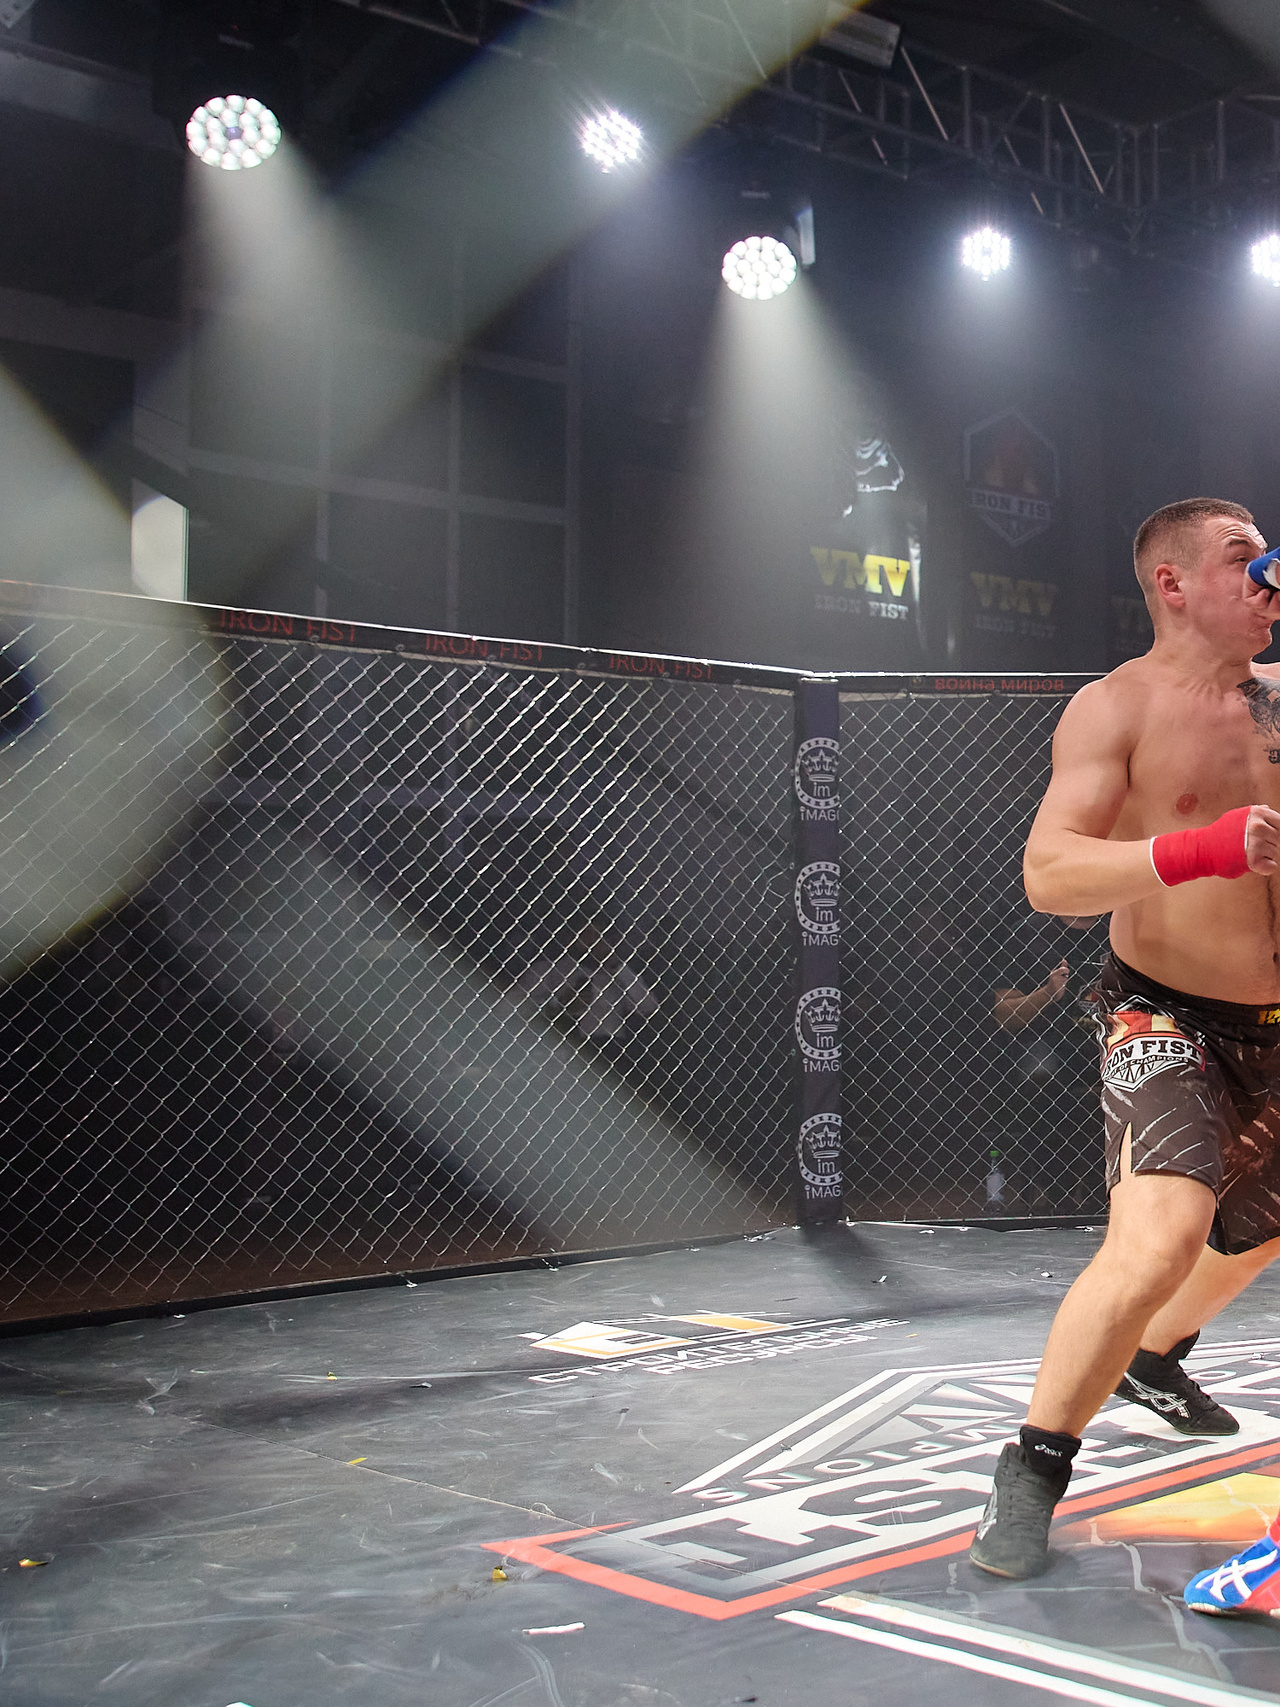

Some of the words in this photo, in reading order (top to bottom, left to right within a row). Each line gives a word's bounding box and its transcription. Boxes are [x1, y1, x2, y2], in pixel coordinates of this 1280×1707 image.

[810, 546, 911, 597] VMV
[868, 601, 910, 620] FIST
[218, 610, 293, 636] IRON
[306, 620, 357, 642] FIST
[424, 634, 489, 657] IRON
[499, 643, 544, 661] FIST
[608, 655, 666, 674] IRON
[673, 663, 714, 679] FIST
[813, 782, 831, 797] im
[815, 907, 834, 921] im
[816, 1033, 835, 1048] im
[1140, 1040, 1201, 1060] FIST
[817, 1159, 836, 1174] im
[528, 1318, 911, 1384] СТРОИТЕЛЬНЫЕ
[641, 1334, 878, 1376] РЕСУРСЫ
